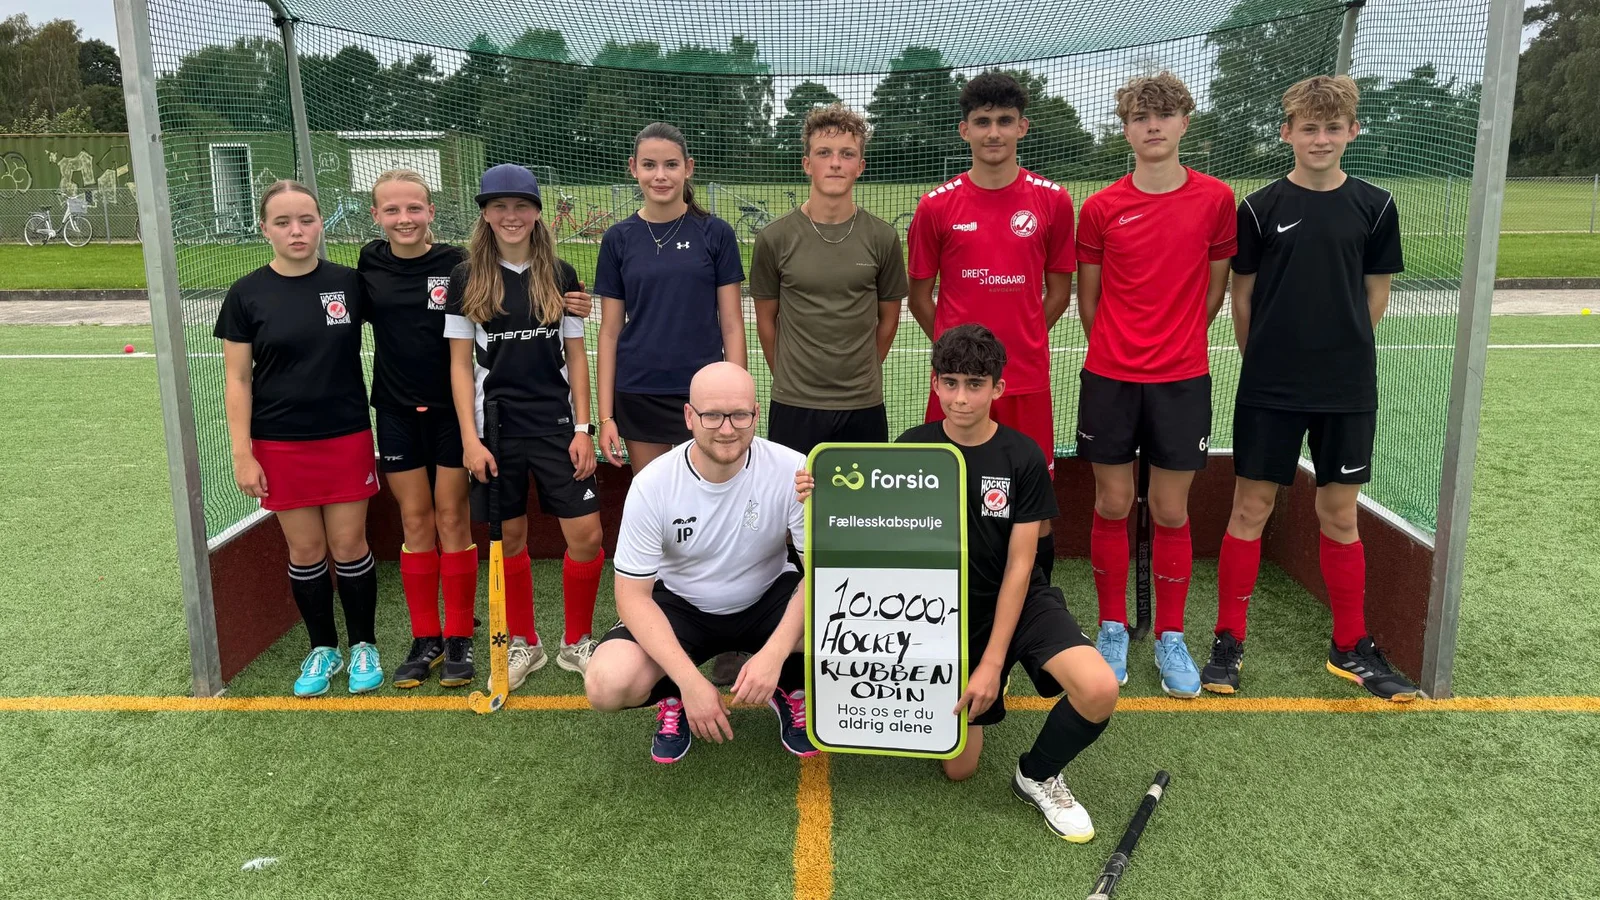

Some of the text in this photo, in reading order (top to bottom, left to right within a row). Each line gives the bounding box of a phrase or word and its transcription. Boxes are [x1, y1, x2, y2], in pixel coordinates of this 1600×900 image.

[962, 269, 989, 278] DREIST
[979, 275, 1026, 285] STORGAARD
[871, 468, 940, 490] forsia
[980, 479, 1011, 497] HOCKEY
[981, 503, 1010, 519] AKADEMI
[828, 515, 943, 530] Fællesskabspulje
[676, 526, 694, 544] JP
[829, 577, 959, 626] 10.000,-
[1138, 579, 1150, 618] OSAKA
[820, 659, 954, 685] KLUBBEN
[837, 703, 934, 720] Hos os er du
[838, 716, 933, 734] aldrig alene
